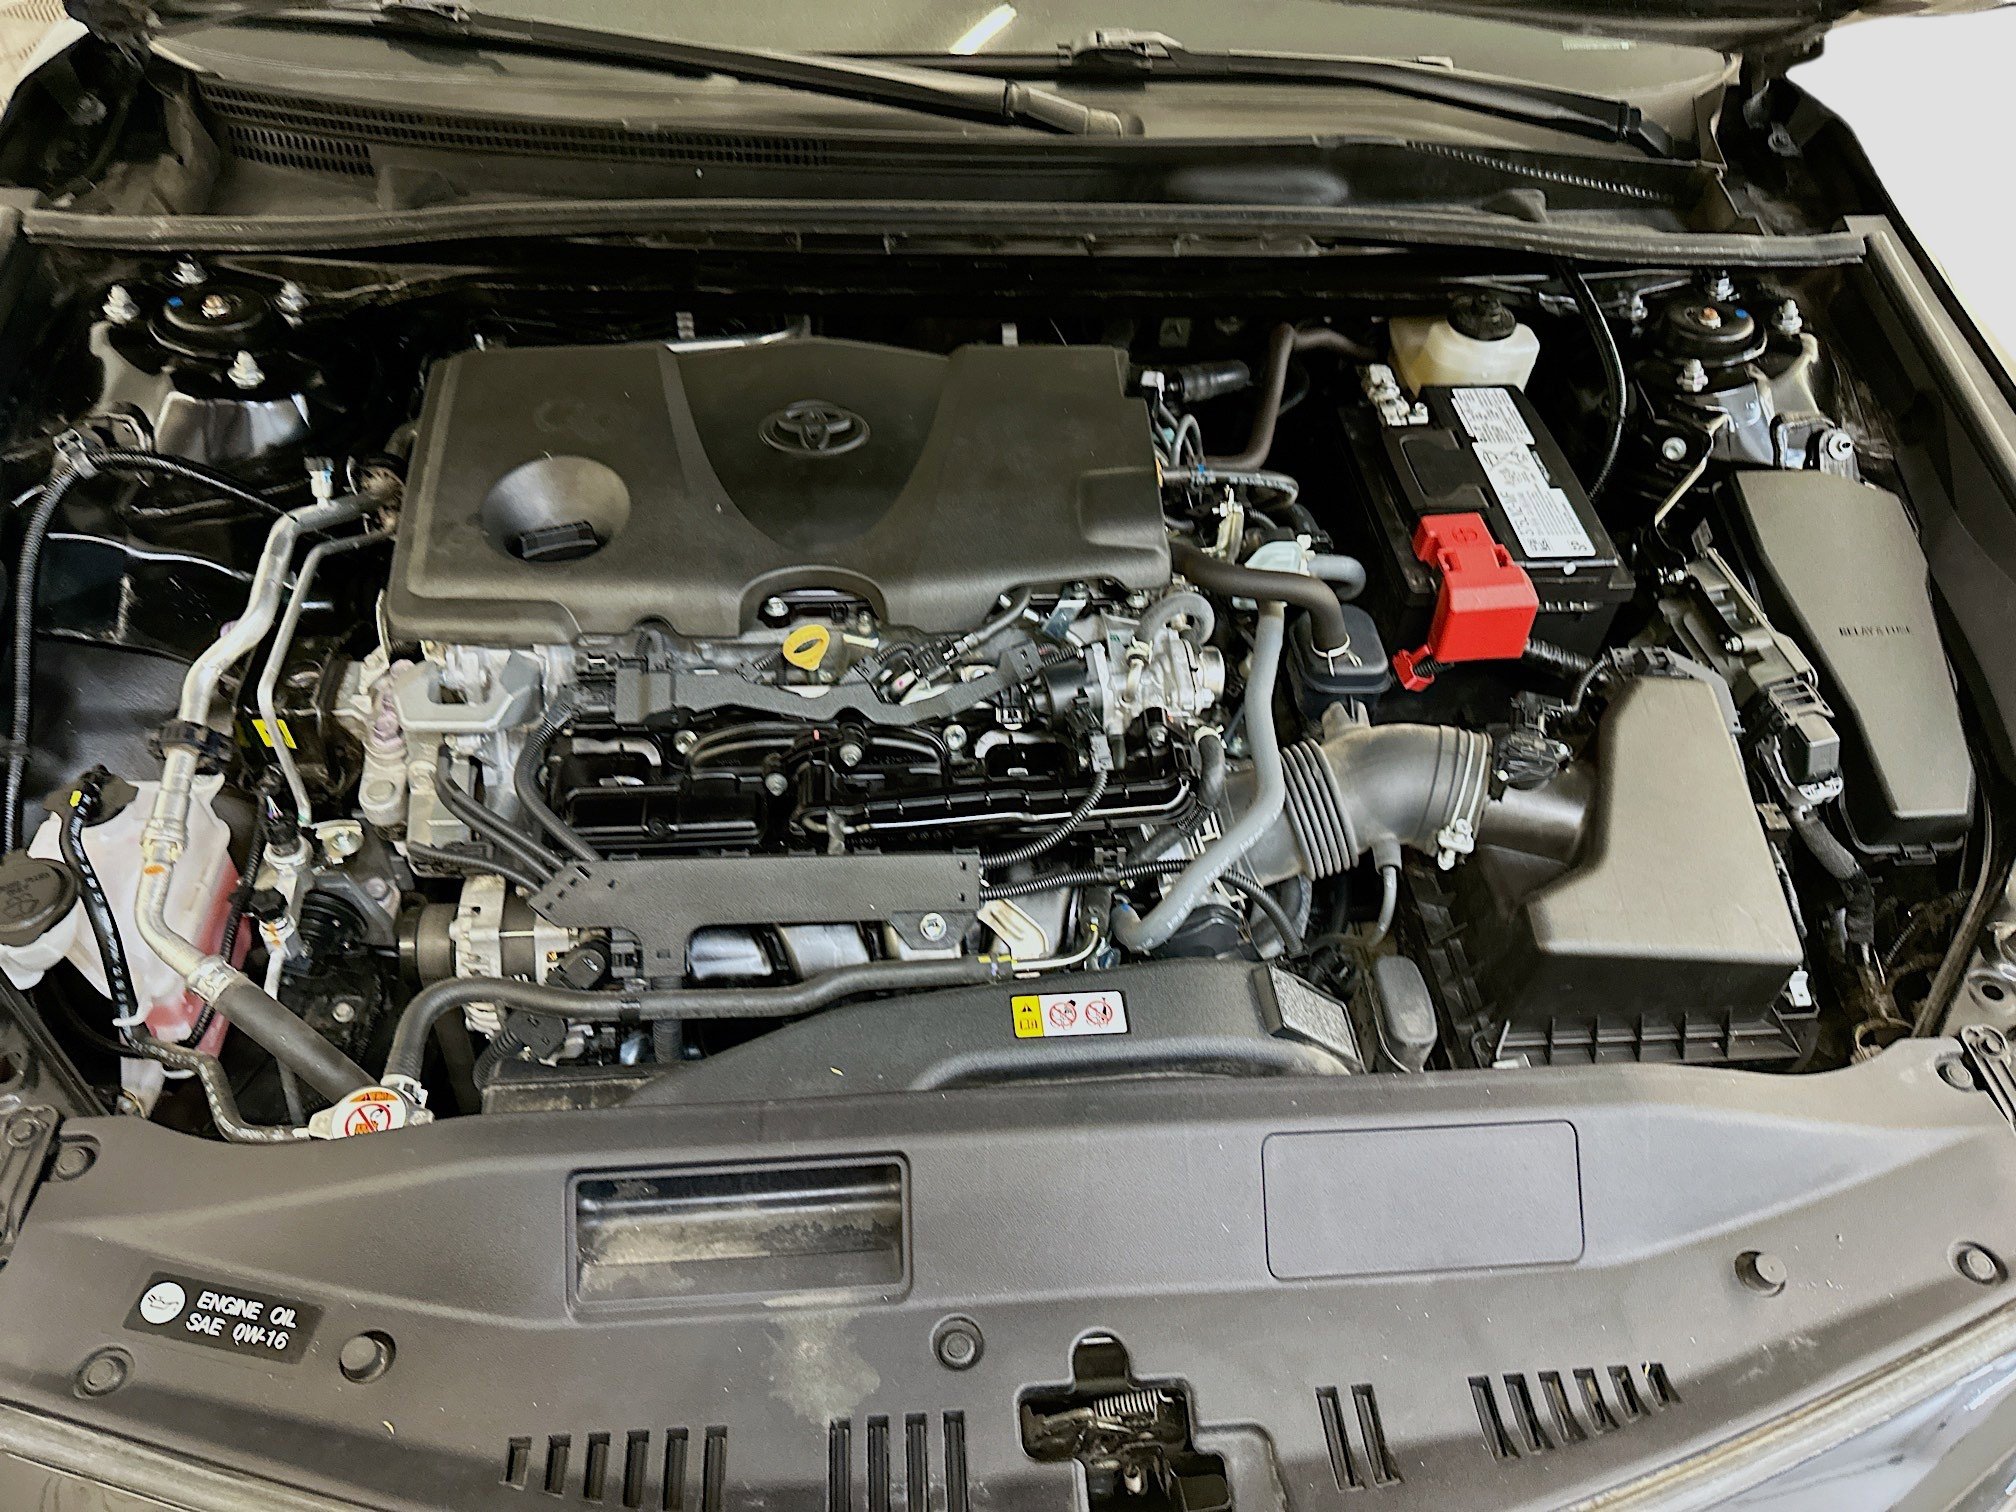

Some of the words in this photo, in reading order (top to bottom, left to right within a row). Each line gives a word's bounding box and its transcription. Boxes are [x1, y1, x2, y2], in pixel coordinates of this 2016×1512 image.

[196, 1290, 264, 1321] ENGINE
[269, 1306, 297, 1329] OIL
[186, 1312, 227, 1337] SAE
[232, 1322, 290, 1351] 0W-16
